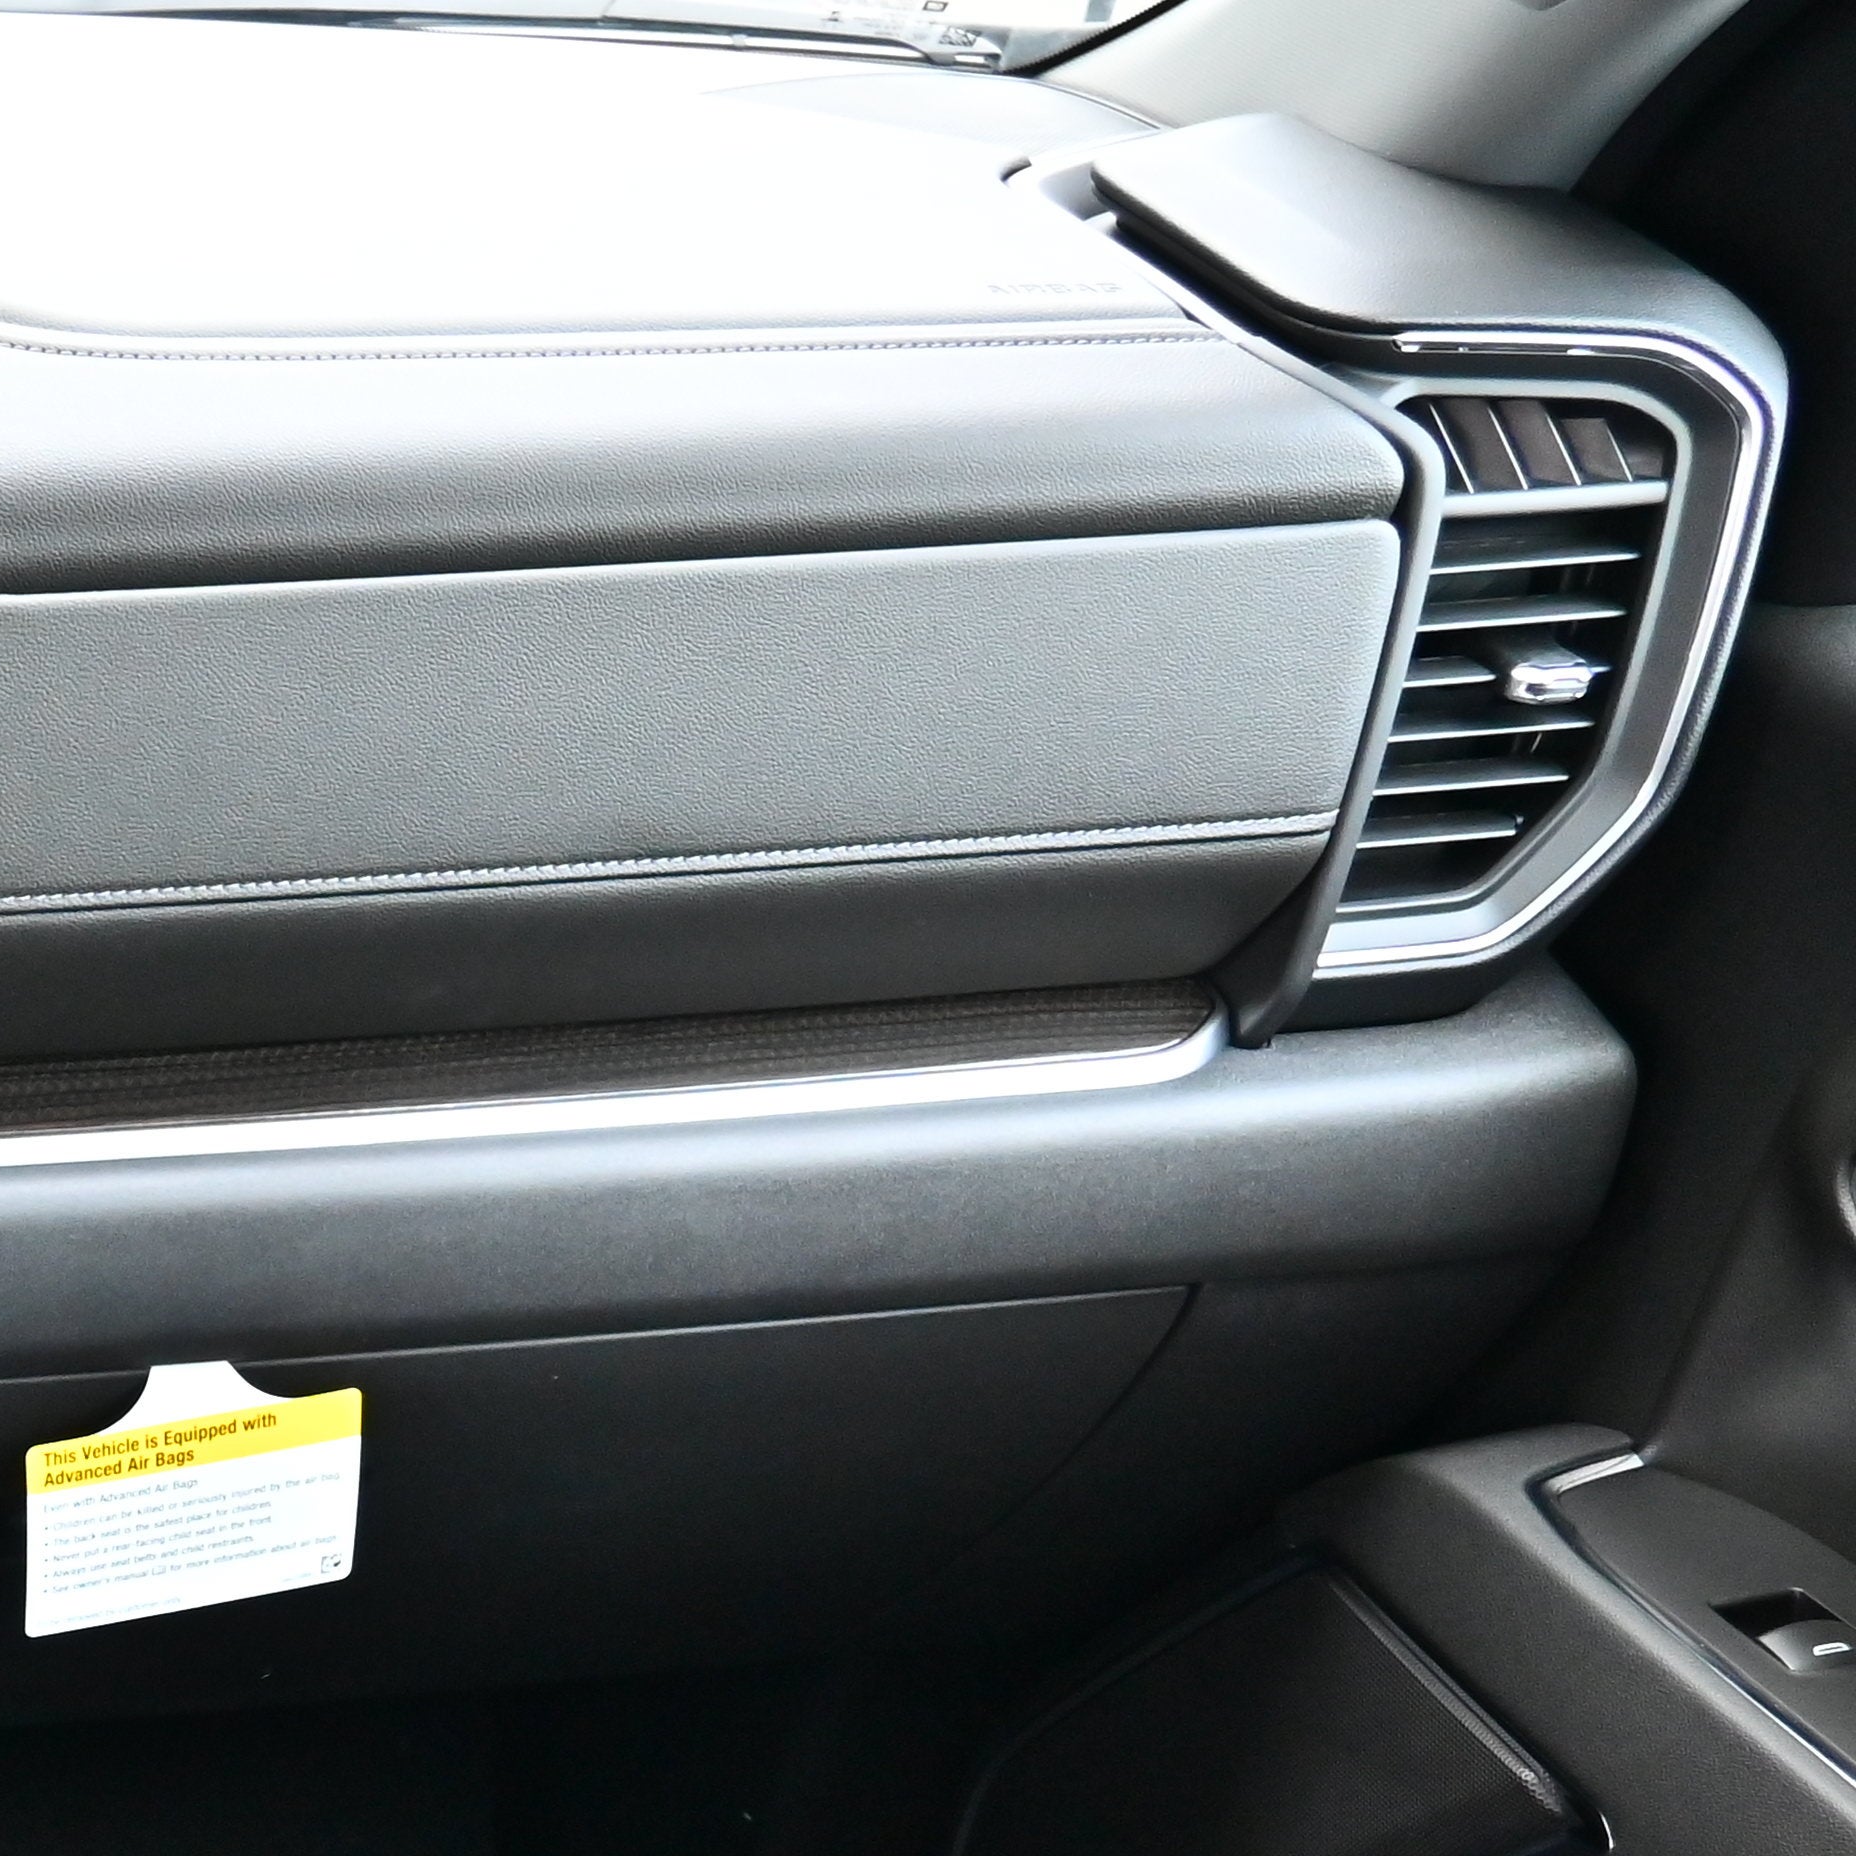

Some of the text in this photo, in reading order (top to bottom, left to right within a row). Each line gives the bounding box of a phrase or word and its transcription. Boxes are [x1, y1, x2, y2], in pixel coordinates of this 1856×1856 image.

[44, 1413, 277, 1467] This Vehicle is Equipped with
[44, 1449, 195, 1488] Advanced Air Bags
[99, 1486, 152, 1502] Advanced
